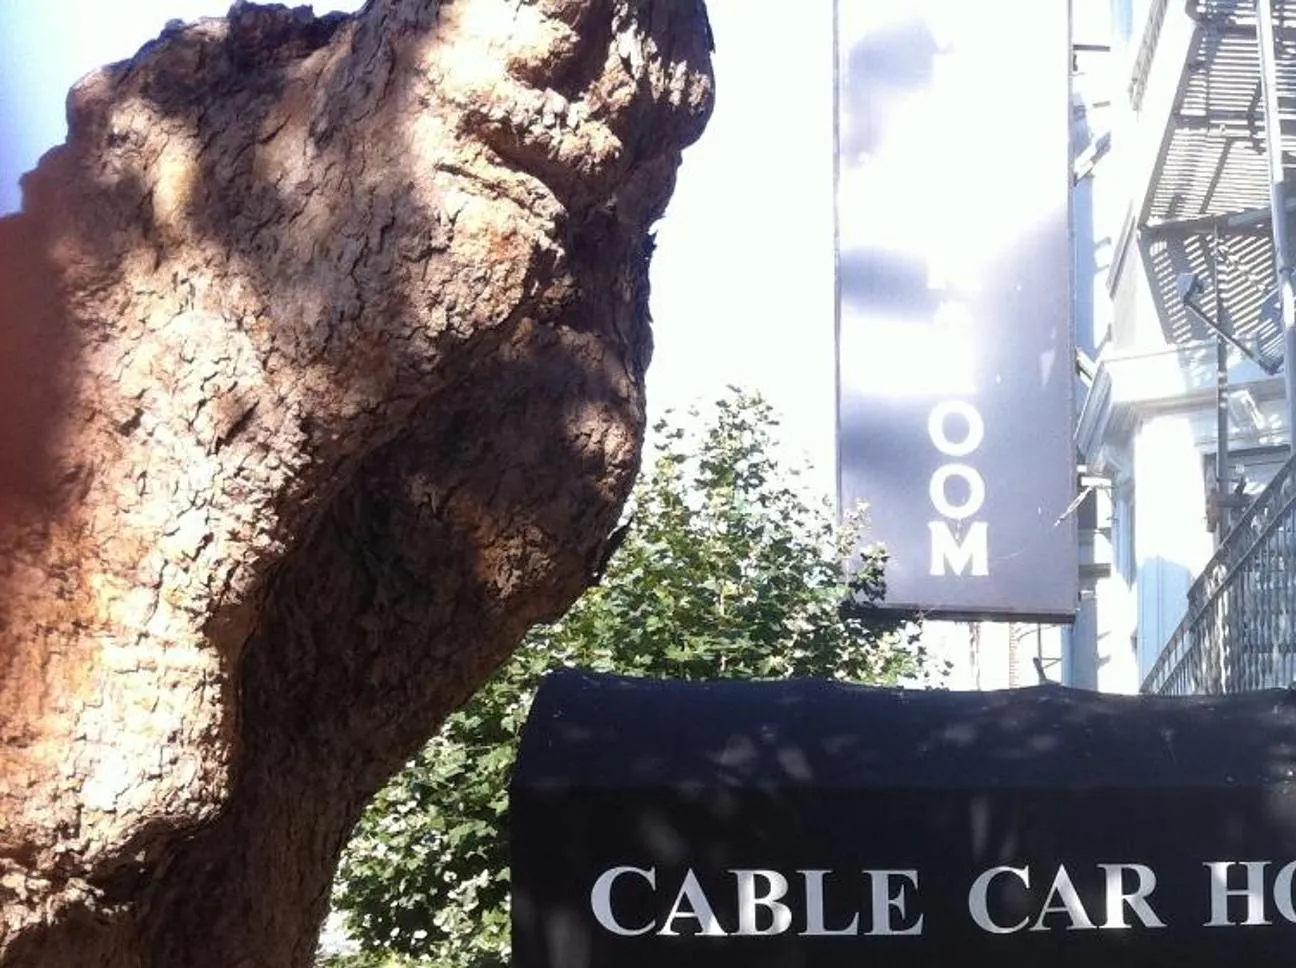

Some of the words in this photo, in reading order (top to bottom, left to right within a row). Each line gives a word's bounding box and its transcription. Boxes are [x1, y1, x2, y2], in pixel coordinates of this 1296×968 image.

[928, 399, 990, 577] OOM
[589, 865, 924, 936] CABLE
[967, 864, 1168, 933] CAR
